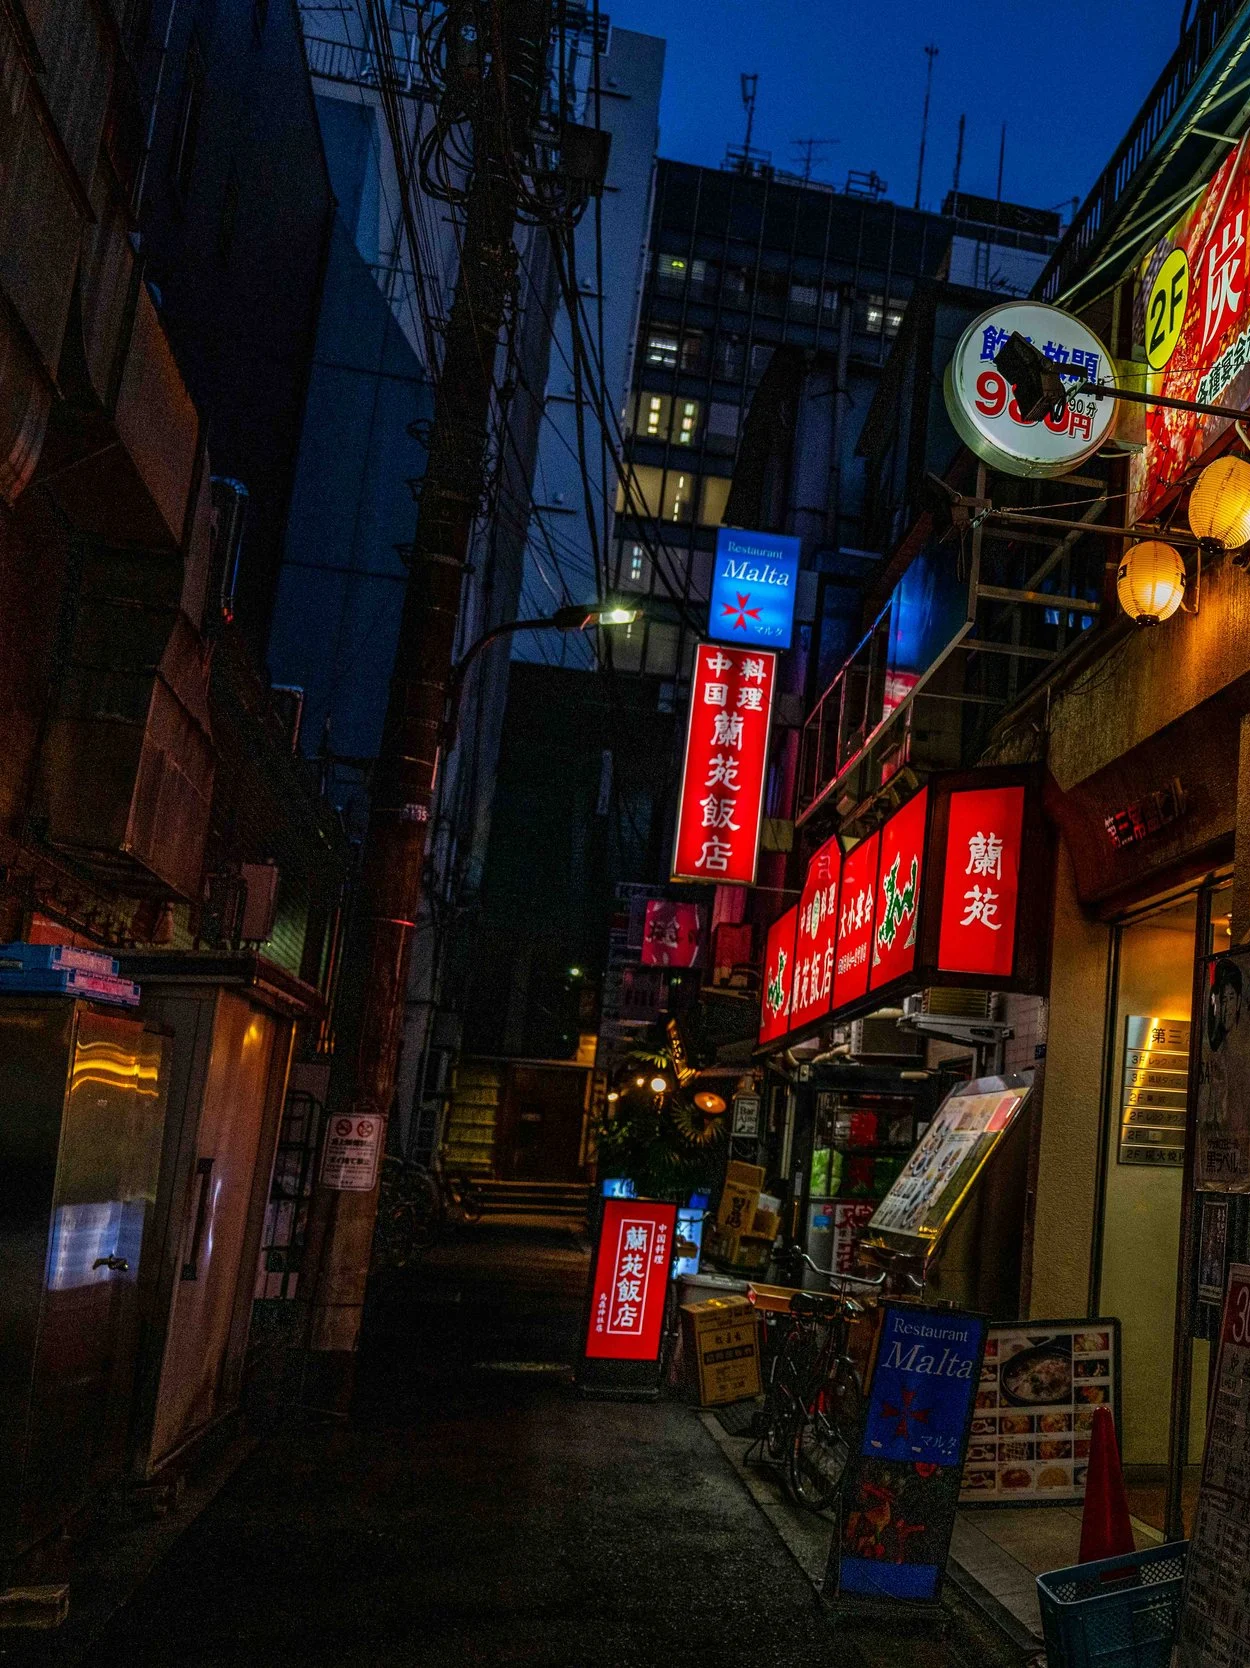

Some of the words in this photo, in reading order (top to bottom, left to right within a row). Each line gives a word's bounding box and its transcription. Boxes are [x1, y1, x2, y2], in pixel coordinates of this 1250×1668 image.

[1148, 263, 1186, 355] 2F
[979, 324, 1100, 385] 飲放題
[1068, 398, 1098, 420] 90分
[727, 540, 784, 560] Restaurant
[722, 559, 790, 587] Malta
[754, 624, 784, 637] マルタ
[703, 651, 733, 707] 中国
[737, 657, 767, 712] 料理
[694, 710, 744, 872] 蘭苑飯店
[959, 831, 1004, 931] 蘭苑
[1129, 1093, 1142, 1103] 2F
[1129, 1111, 1144, 1121] 2F
[1127, 1130, 1142, 1140] 2F
[1126, 1149, 1141, 1159] 2F
[654, 1223, 668, 1265] 中国料理
[613, 1225, 648, 1328] 蘭苑飯店
[892, 1317, 968, 1343] Restaurant
[881, 1340, 974, 1380] Malta
[920, 1434, 958, 1448] マルタ
